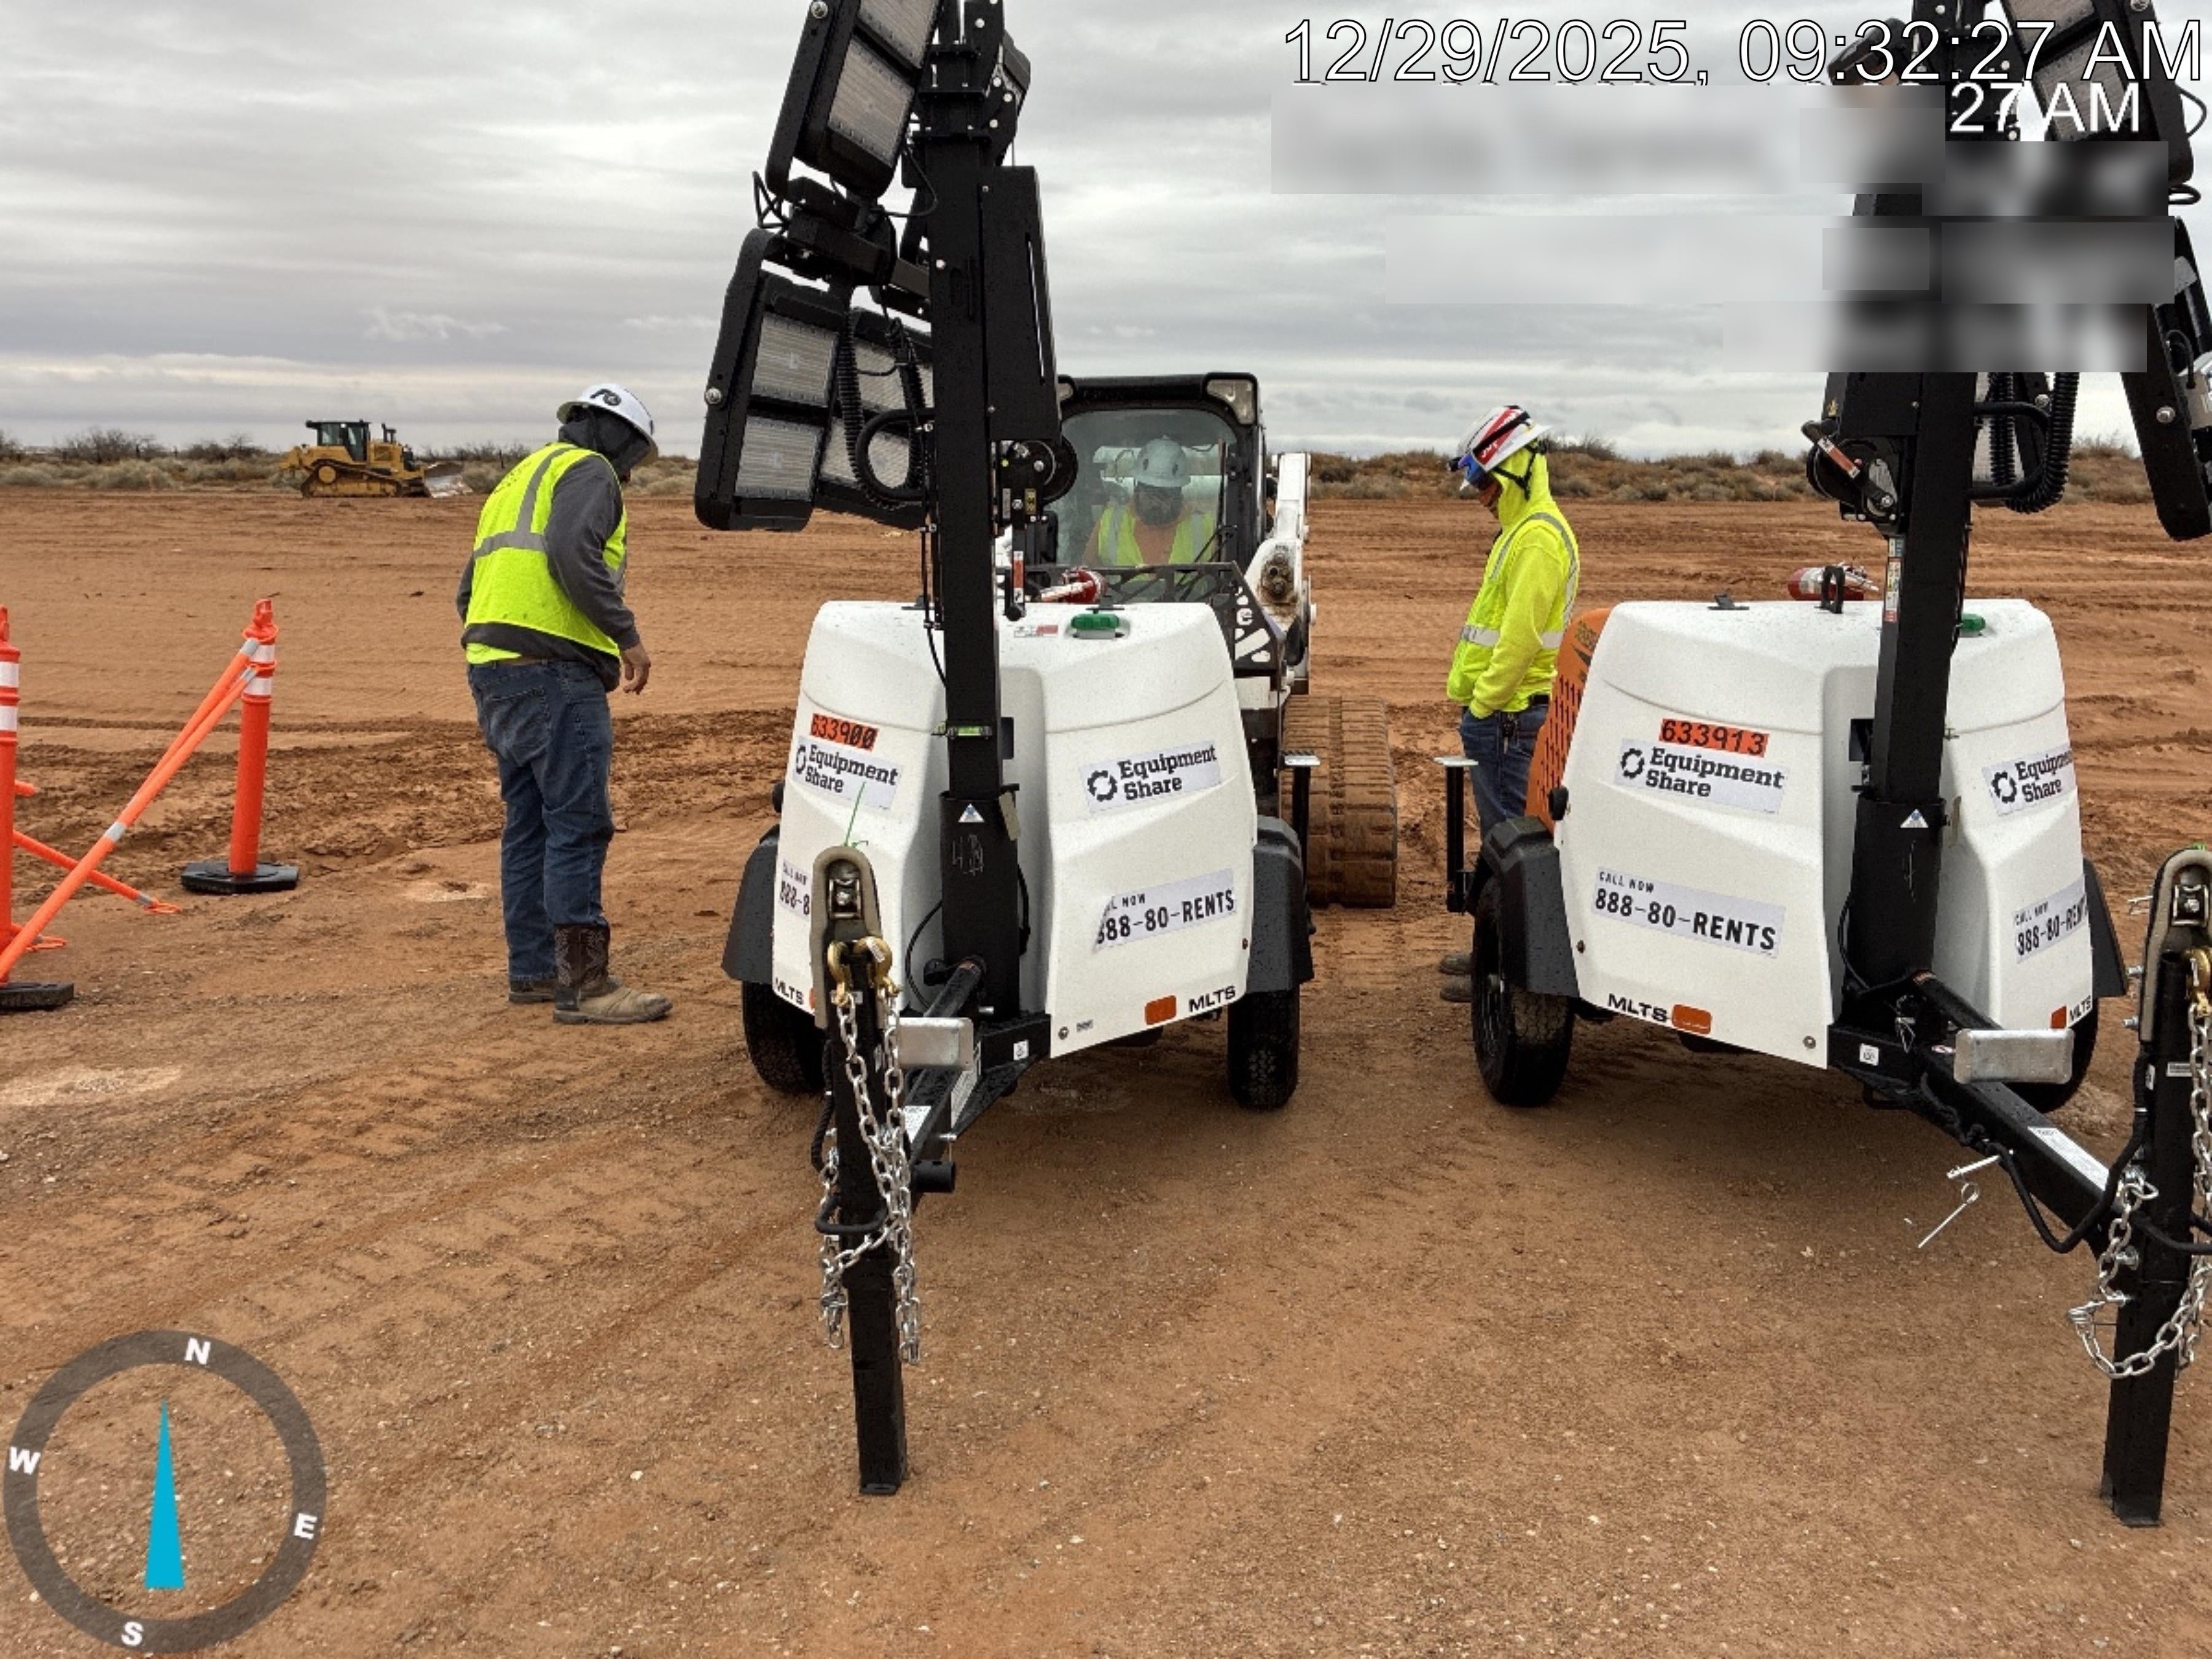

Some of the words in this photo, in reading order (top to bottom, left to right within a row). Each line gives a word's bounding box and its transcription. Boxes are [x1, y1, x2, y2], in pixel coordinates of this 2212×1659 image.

[1661, 720, 1765, 755] 633913
[809, 744, 898, 785] Equipment
[1117, 745, 1217, 780] Equipment
[1650, 746, 1784, 789] Equipment
[806, 766, 844, 793] Share
[1124, 777, 1182, 801] Share
[1646, 769, 1711, 797] Share
[2022, 779, 2061, 802] Share
[1599, 871, 1625, 887] CALL
[1630, 879, 1654, 893] NOW
[1123, 893, 1145, 908] NOW
[1596, 888, 1776, 950] 888-80-RENTS
[1188, 986, 1236, 1013] MLTS
[1608, 993, 1668, 1022] MLTS
